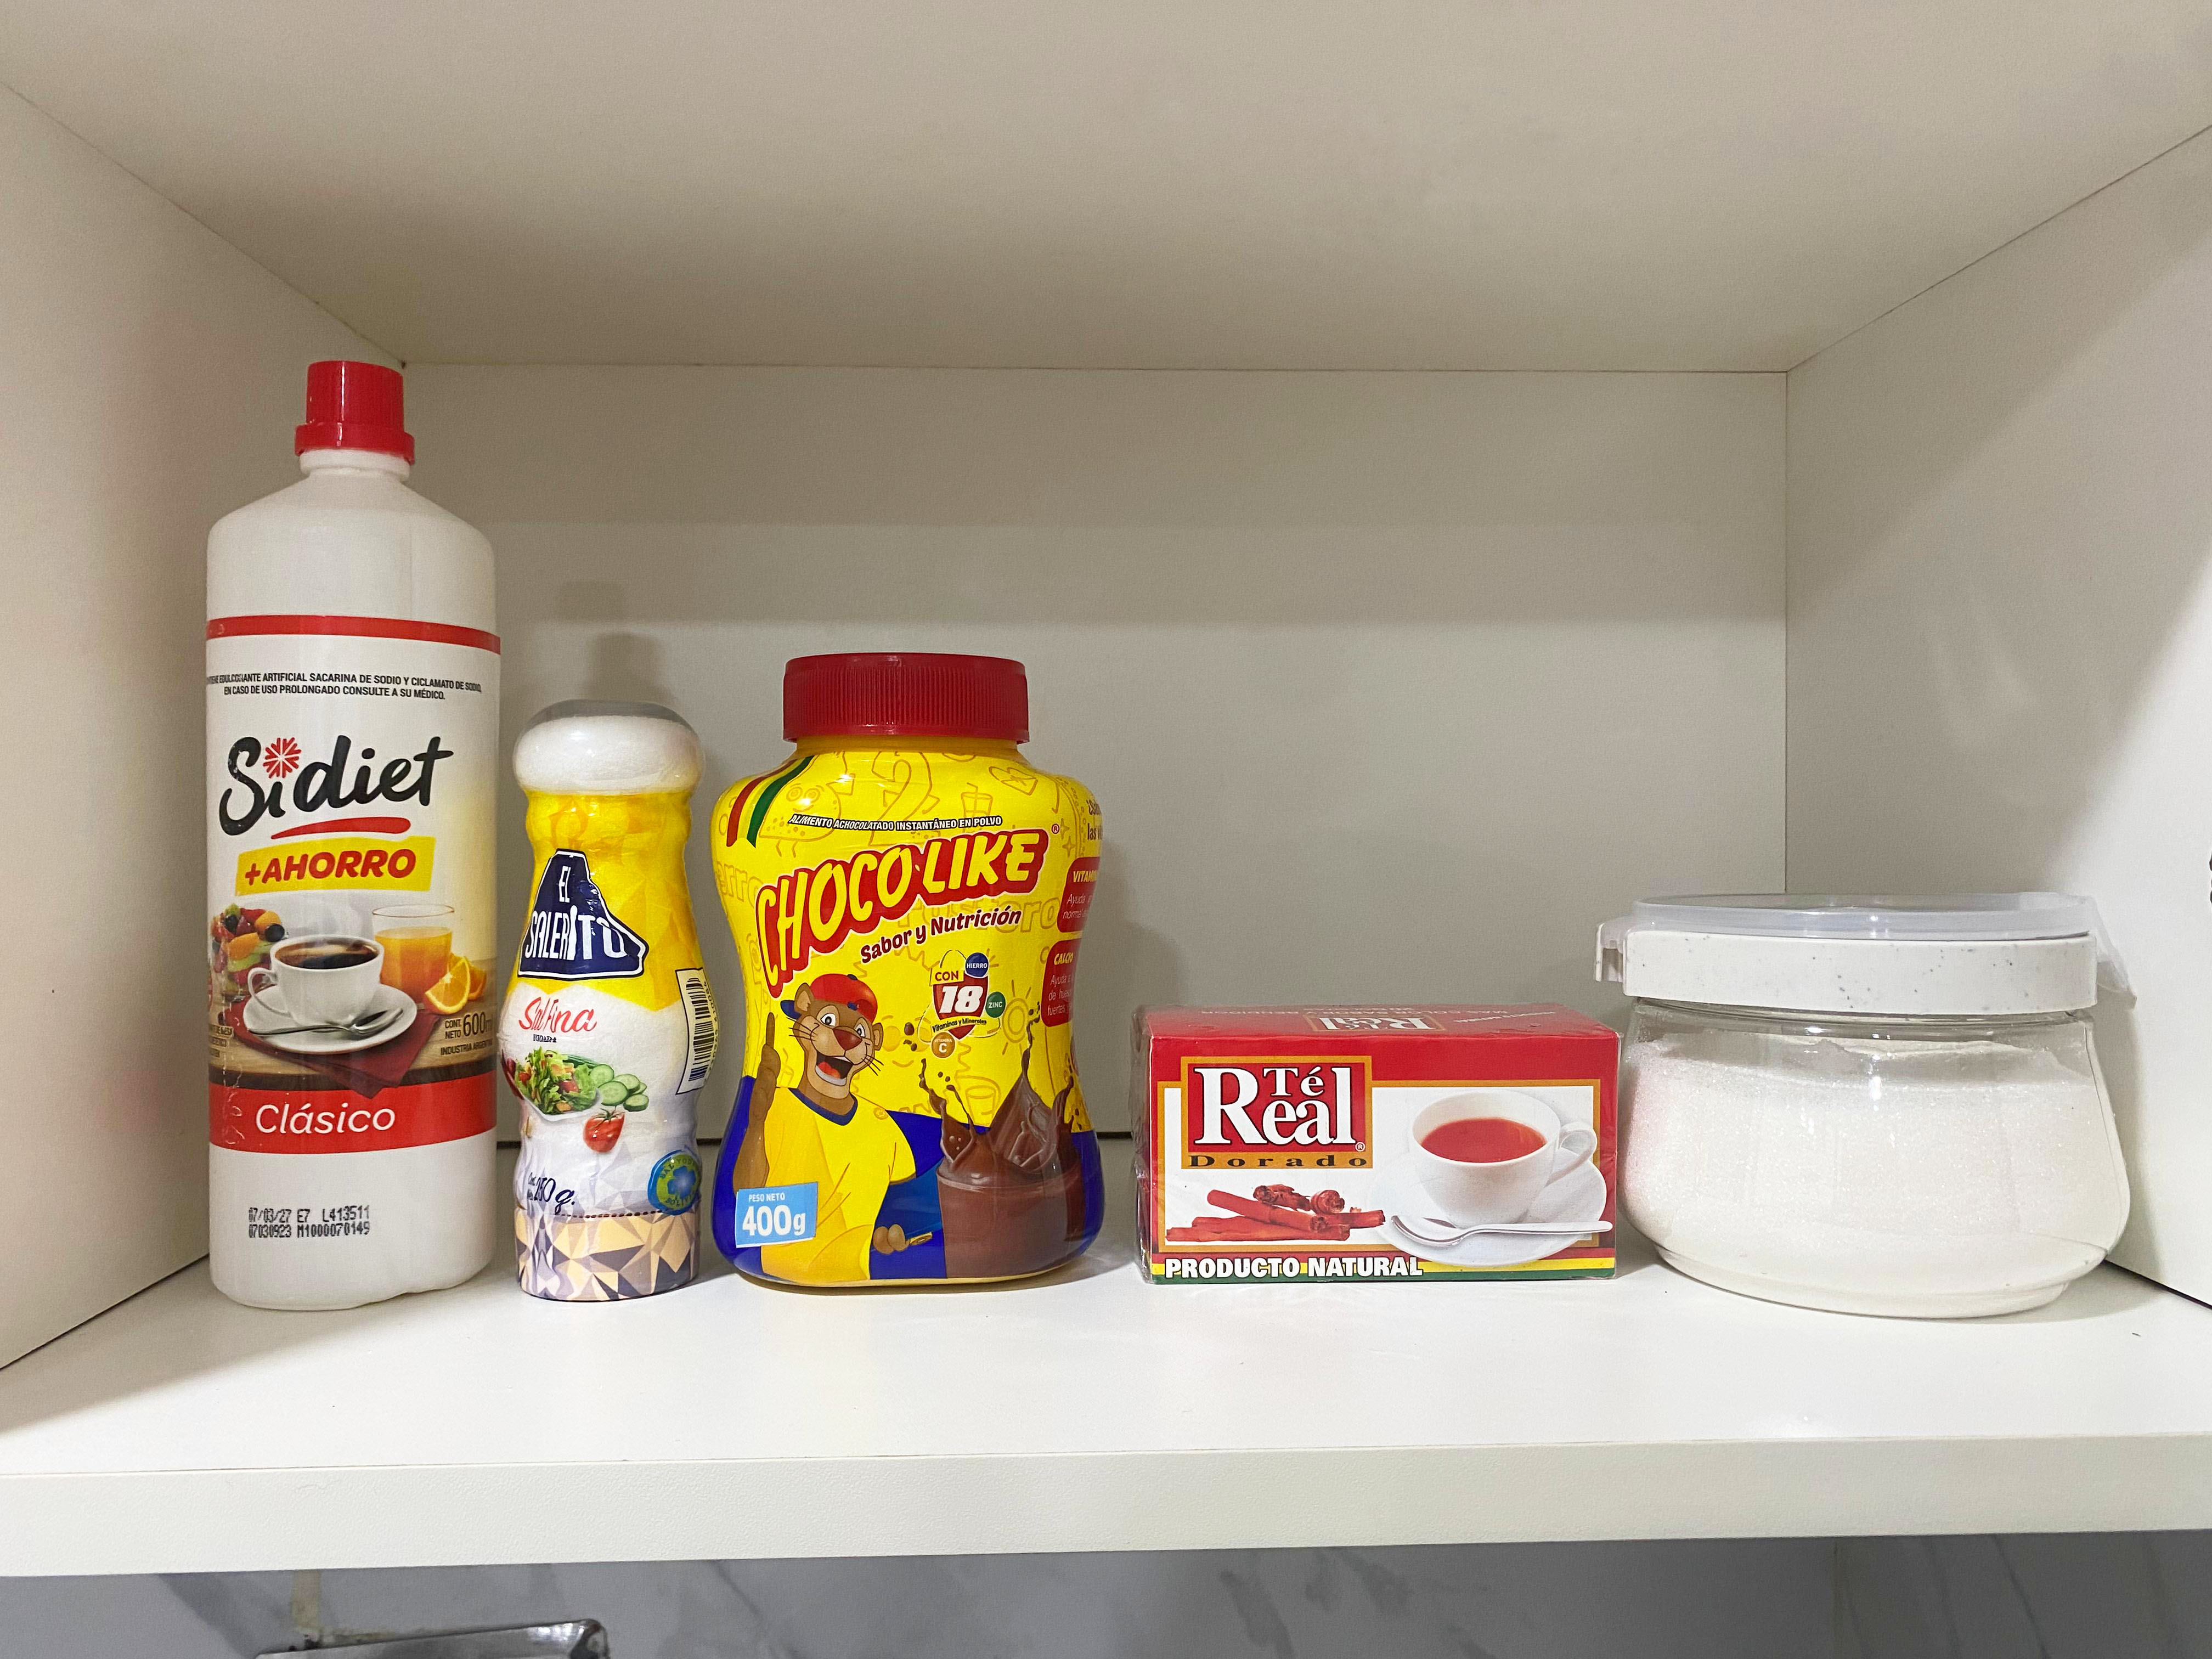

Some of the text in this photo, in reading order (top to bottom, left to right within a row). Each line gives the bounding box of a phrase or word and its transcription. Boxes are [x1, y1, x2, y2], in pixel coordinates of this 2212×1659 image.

[263, 673, 307, 682] ARTIFICIAL
[309, 673, 357, 682] SACARINA
[359, 675, 371, 683] DE
[374, 675, 401, 685] SODIO
[404, 677, 409, 685] Y
[412, 677, 454, 689] CICLAMATO
[456, 681, 464, 690] DE
[224, 686, 231, 695] EN
[233, 686, 249, 695] CASO
[251, 685, 260, 694] DE
[262, 685, 277, 693] USO
[280, 685, 340, 695] PROLONGADO
[342, 686, 390, 696] CONSULTE
[392, 688, 398, 696] A
[400, 689, 411, 697] SU
[219, 735, 454, 836] Sidiet
[789, 814, 1002, 831] ALIMENTO ACHOCOLATADO INSTANTÁNEO EN POLVO
[558, 865, 571, 902] EL
[860, 930, 912, 963] Sabor
[916, 925, 926, 944] y
[931, 906, 1022, 935] Nutrición
[935, 970, 959, 981] CON
[939, 985, 984, 1014] 18
[1048, 990, 1056, 1001] de
[445, 1030, 461, 1039] NETO
[932, 1020, 957, 1032] Vitaminas
[441, 1043, 472, 1056] INDUSTRIA
[939, 1043, 947, 1053] C
[1263, 1064, 1324, 1096] Té
[1194, 1066, 1356, 1146] Real
[255, 1103, 396, 1135] Clásico
[1189, 1155, 1367, 1168] Dorado
[748, 1192, 785, 1203] PESO NETO
[297, 1209, 310, 1223] E7
[742, 1205, 806, 1236] 400g
[1166, 1256, 1424, 1279] PRODUCTO NATURAL
